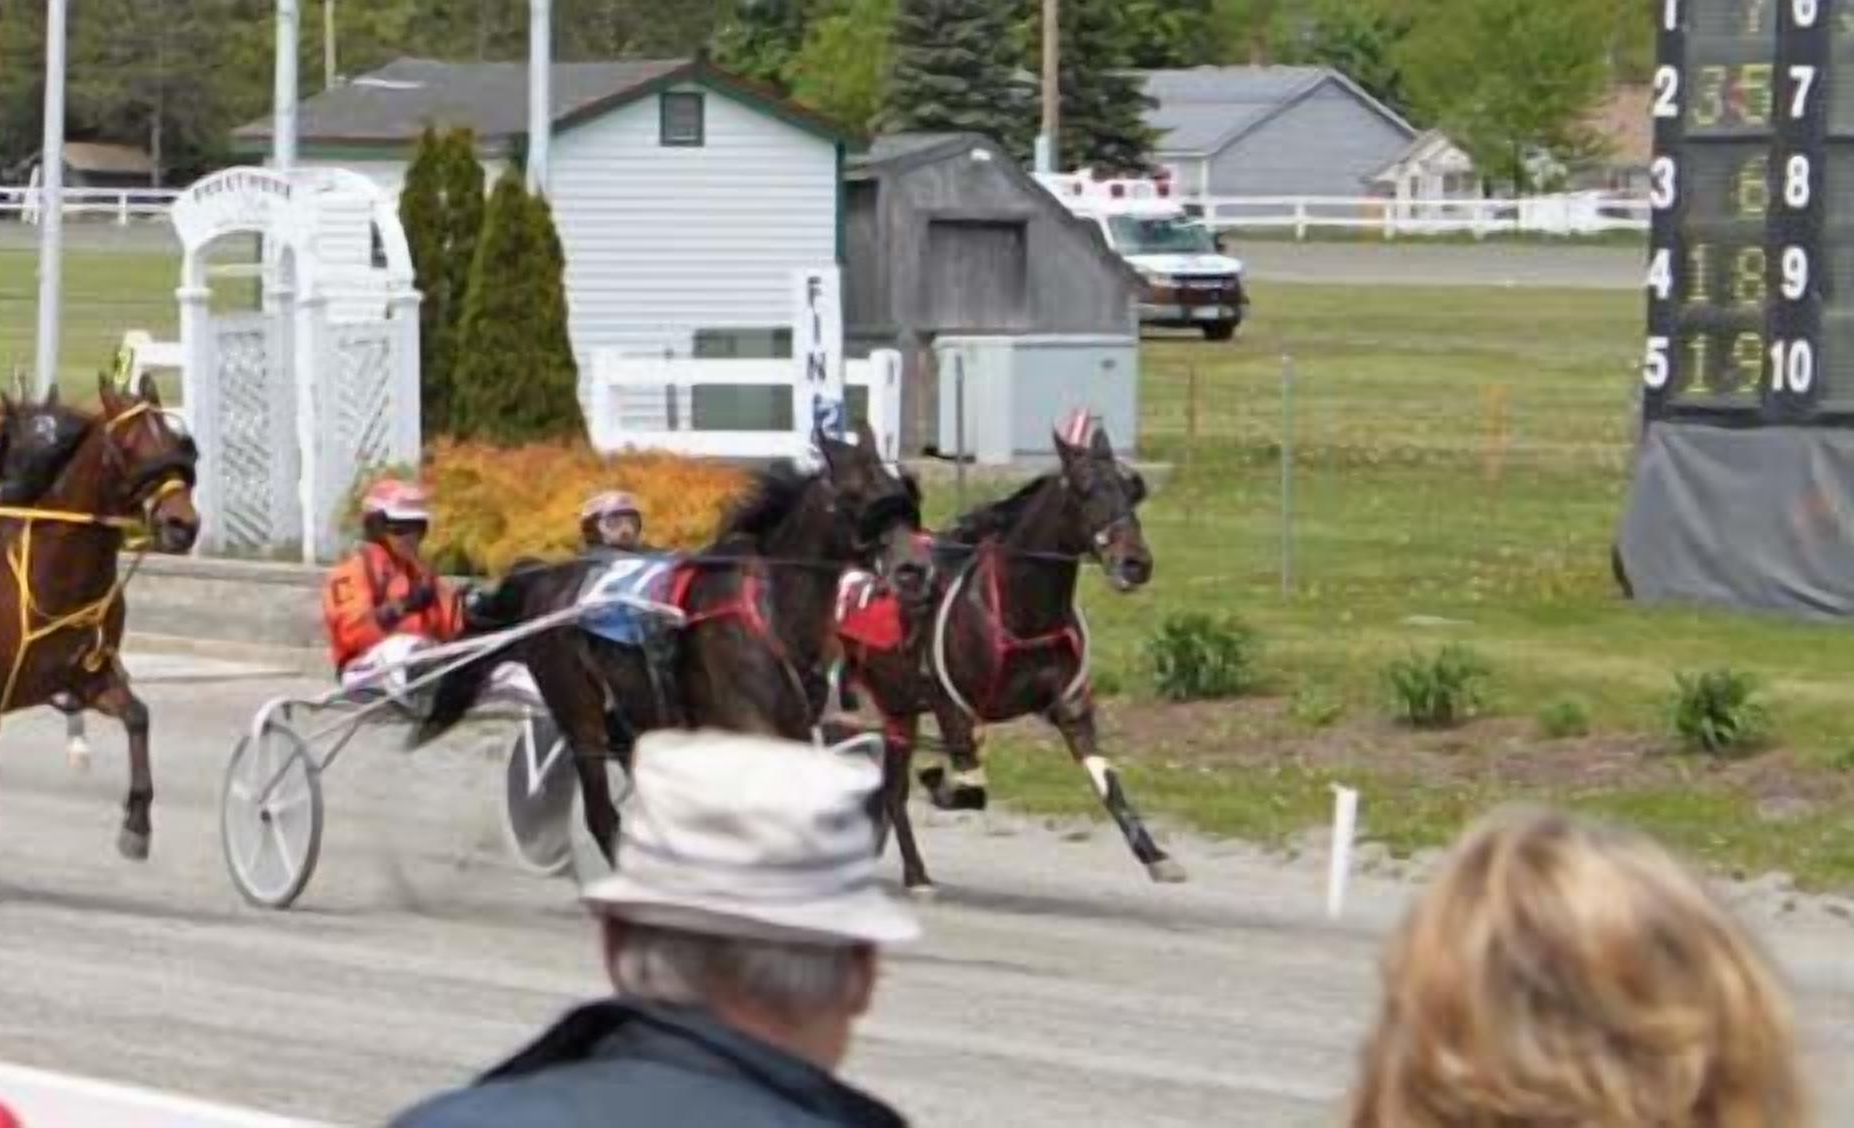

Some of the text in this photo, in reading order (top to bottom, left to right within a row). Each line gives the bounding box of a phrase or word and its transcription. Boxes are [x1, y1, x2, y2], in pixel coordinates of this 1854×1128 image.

[1652, 65, 1678, 118] 2
[1789, 65, 1816, 118] 7
[1650, 156, 1675, 209] 3
[1785, 155, 1810, 208] 8
[1647, 248, 1672, 299] 4
[1781, 246, 1808, 299] 9
[1643, 336, 1669, 387] 5
[1771, 339, 1813, 393] 10
